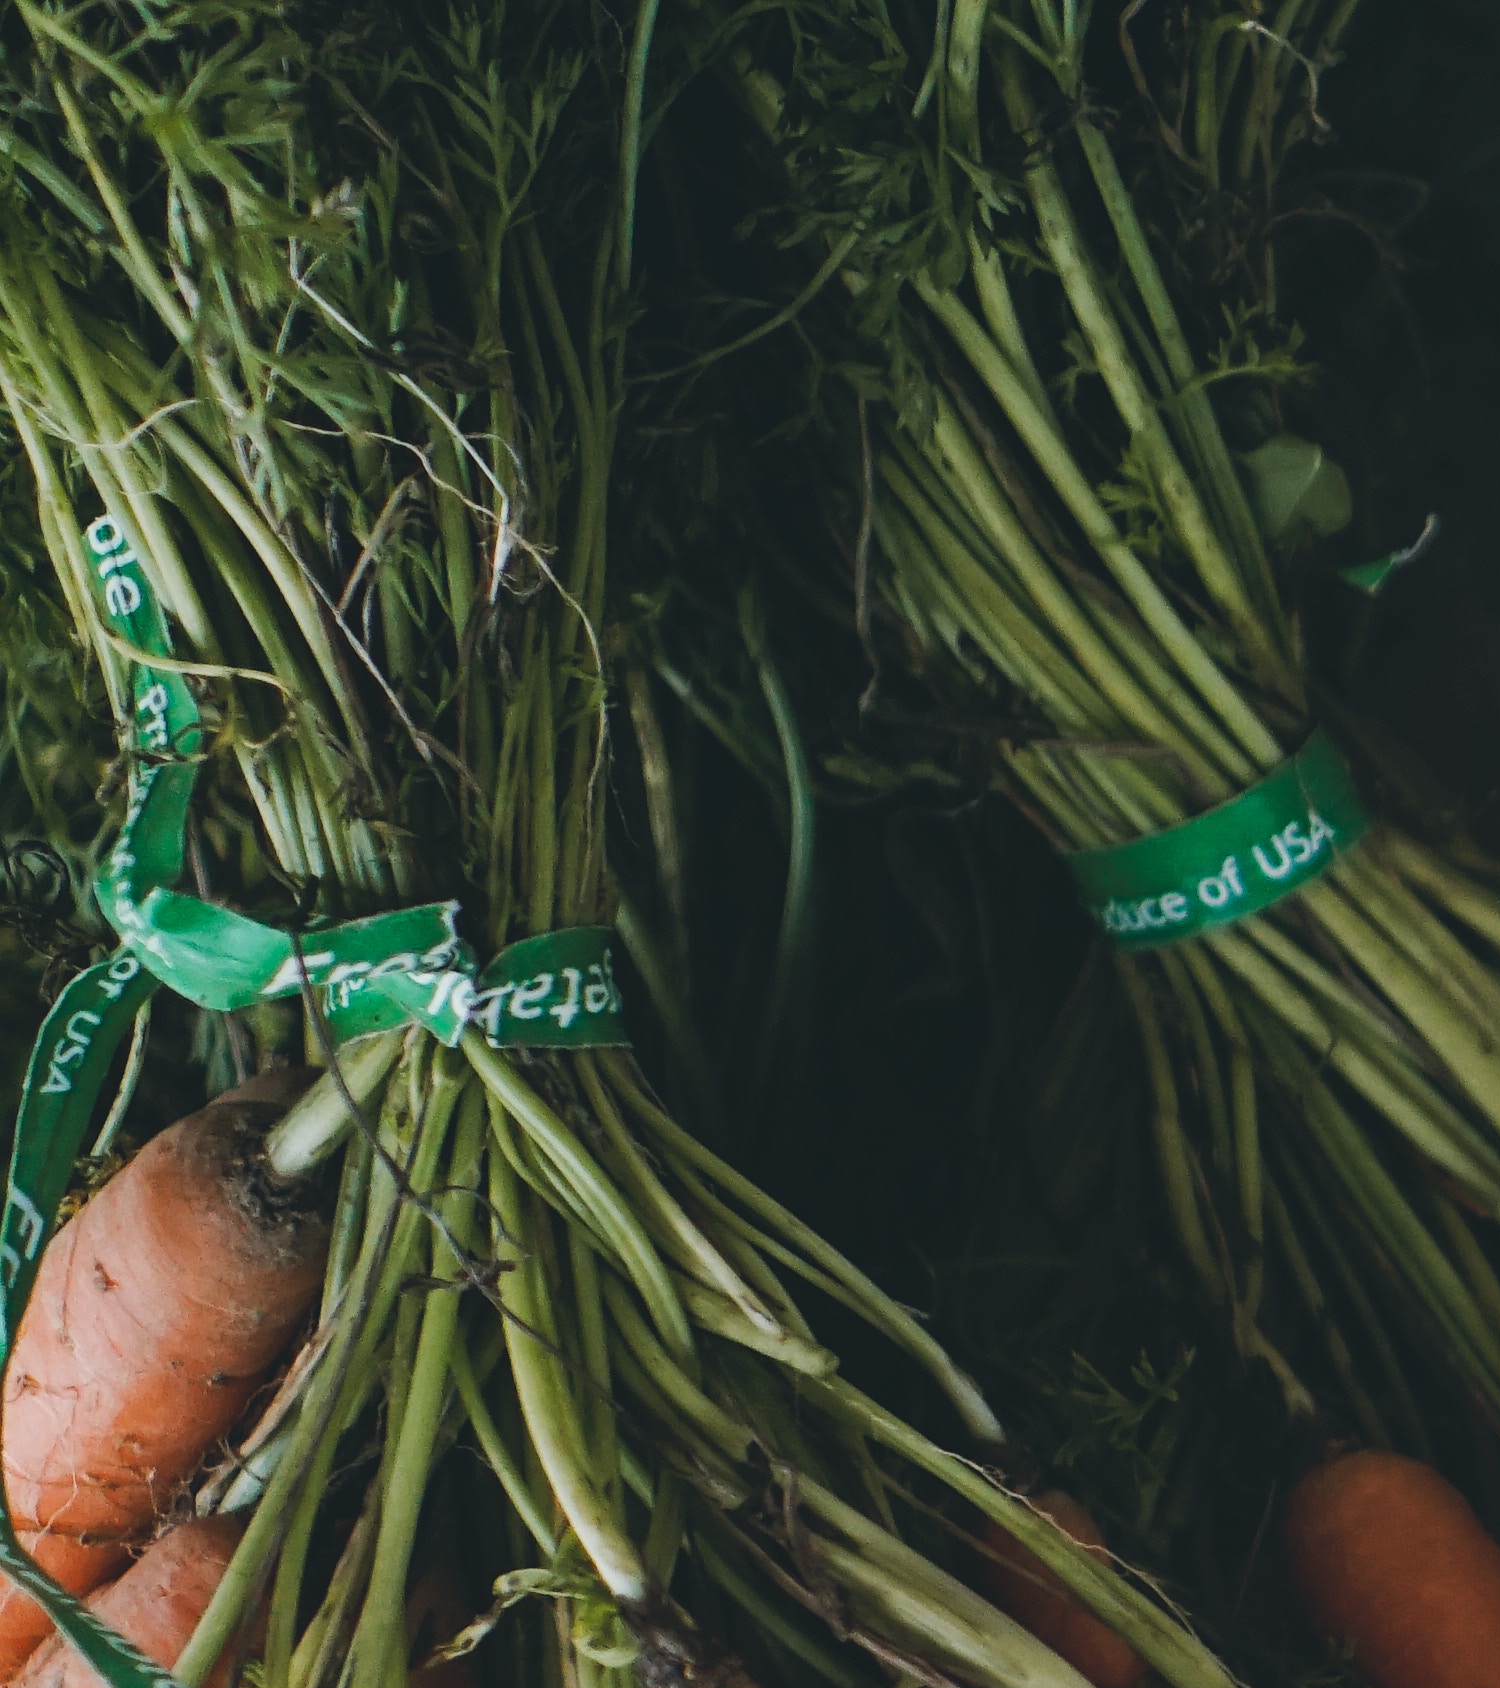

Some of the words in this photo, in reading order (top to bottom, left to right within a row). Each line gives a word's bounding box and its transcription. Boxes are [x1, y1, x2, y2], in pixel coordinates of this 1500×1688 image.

[1198, 855, 1244, 907] of
[1251, 808, 1335, 879] USA
[40, 1010, 101, 1094] USA
